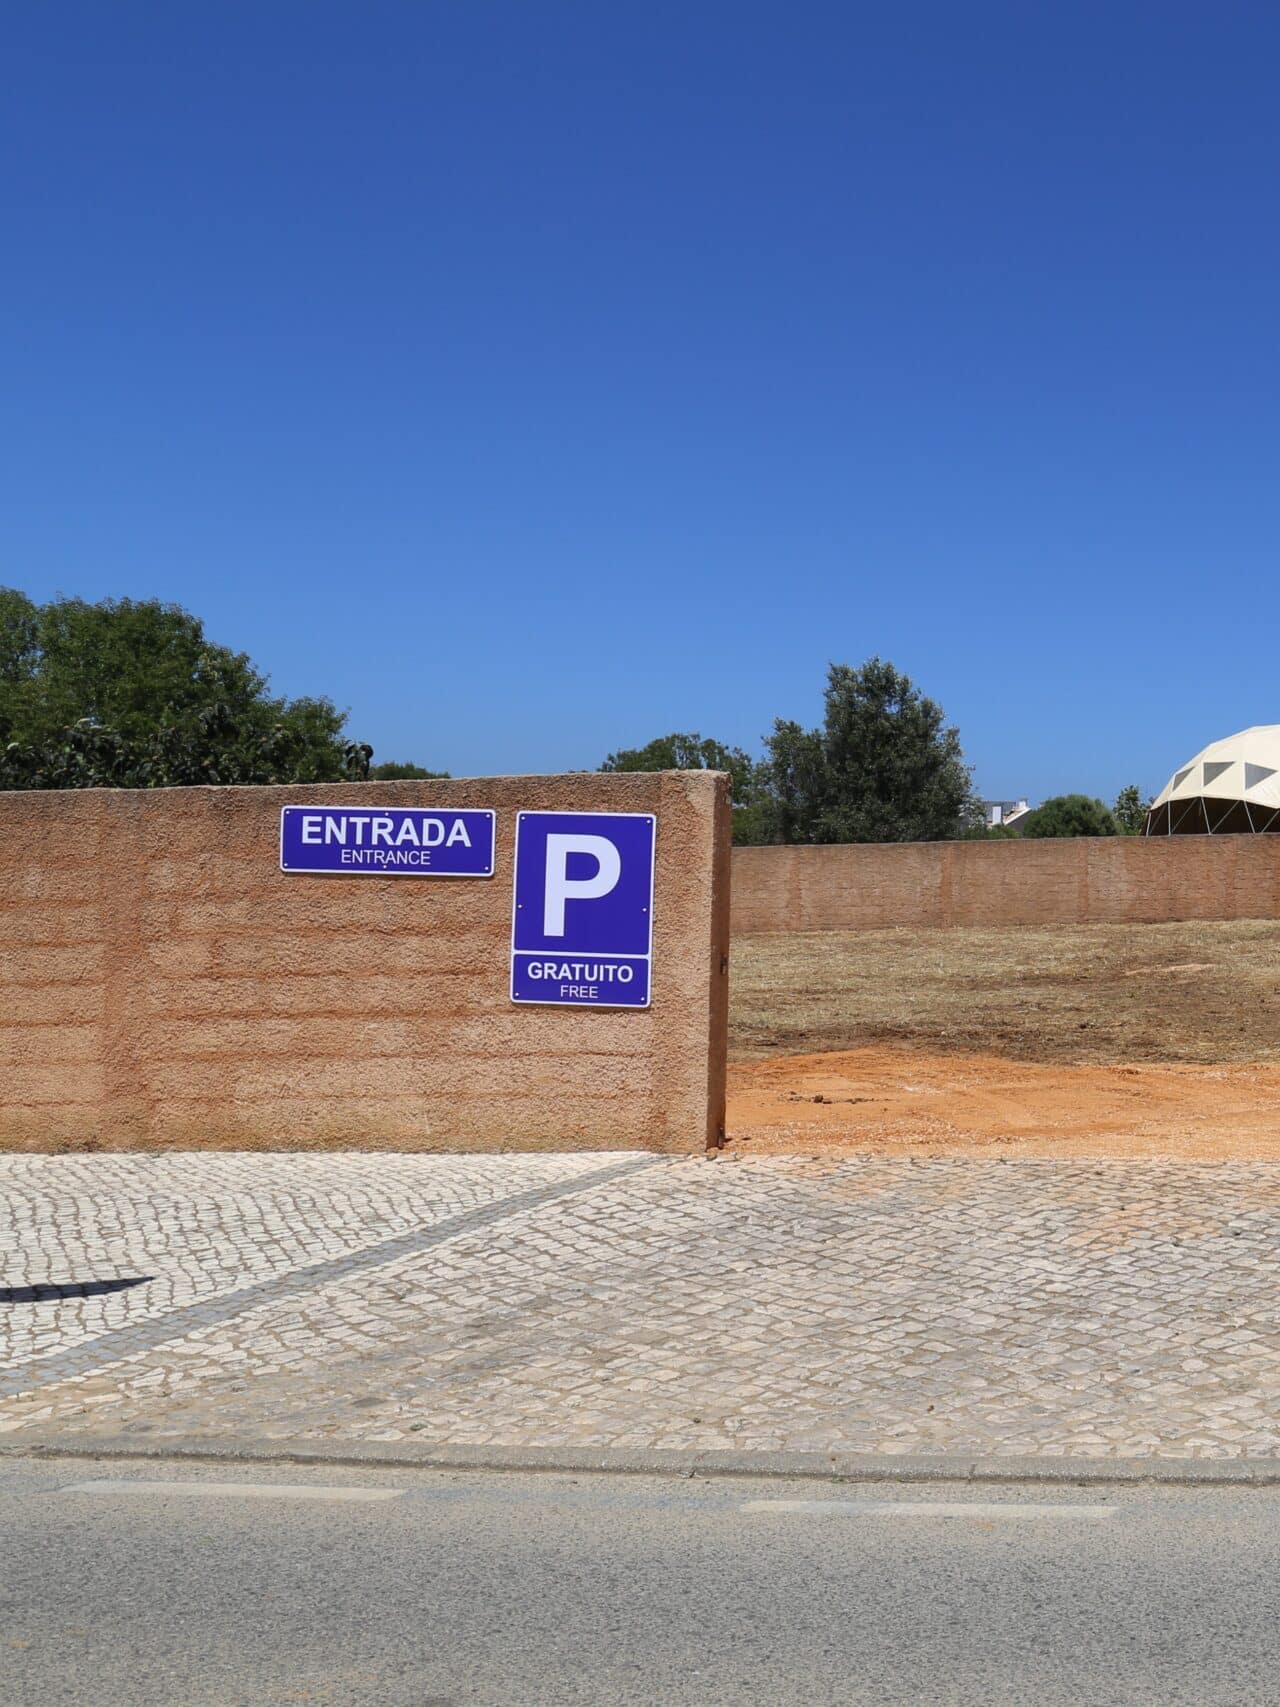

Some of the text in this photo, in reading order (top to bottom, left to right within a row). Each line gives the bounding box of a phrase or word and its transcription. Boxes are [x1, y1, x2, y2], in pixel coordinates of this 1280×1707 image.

[301, 815, 472, 848] ENTRADA
[341, 849, 431, 866] ENTRANCE
[543, 833, 622, 937] P
[527, 961, 634, 983] GRATUITO
[560, 985, 599, 999] FREE
